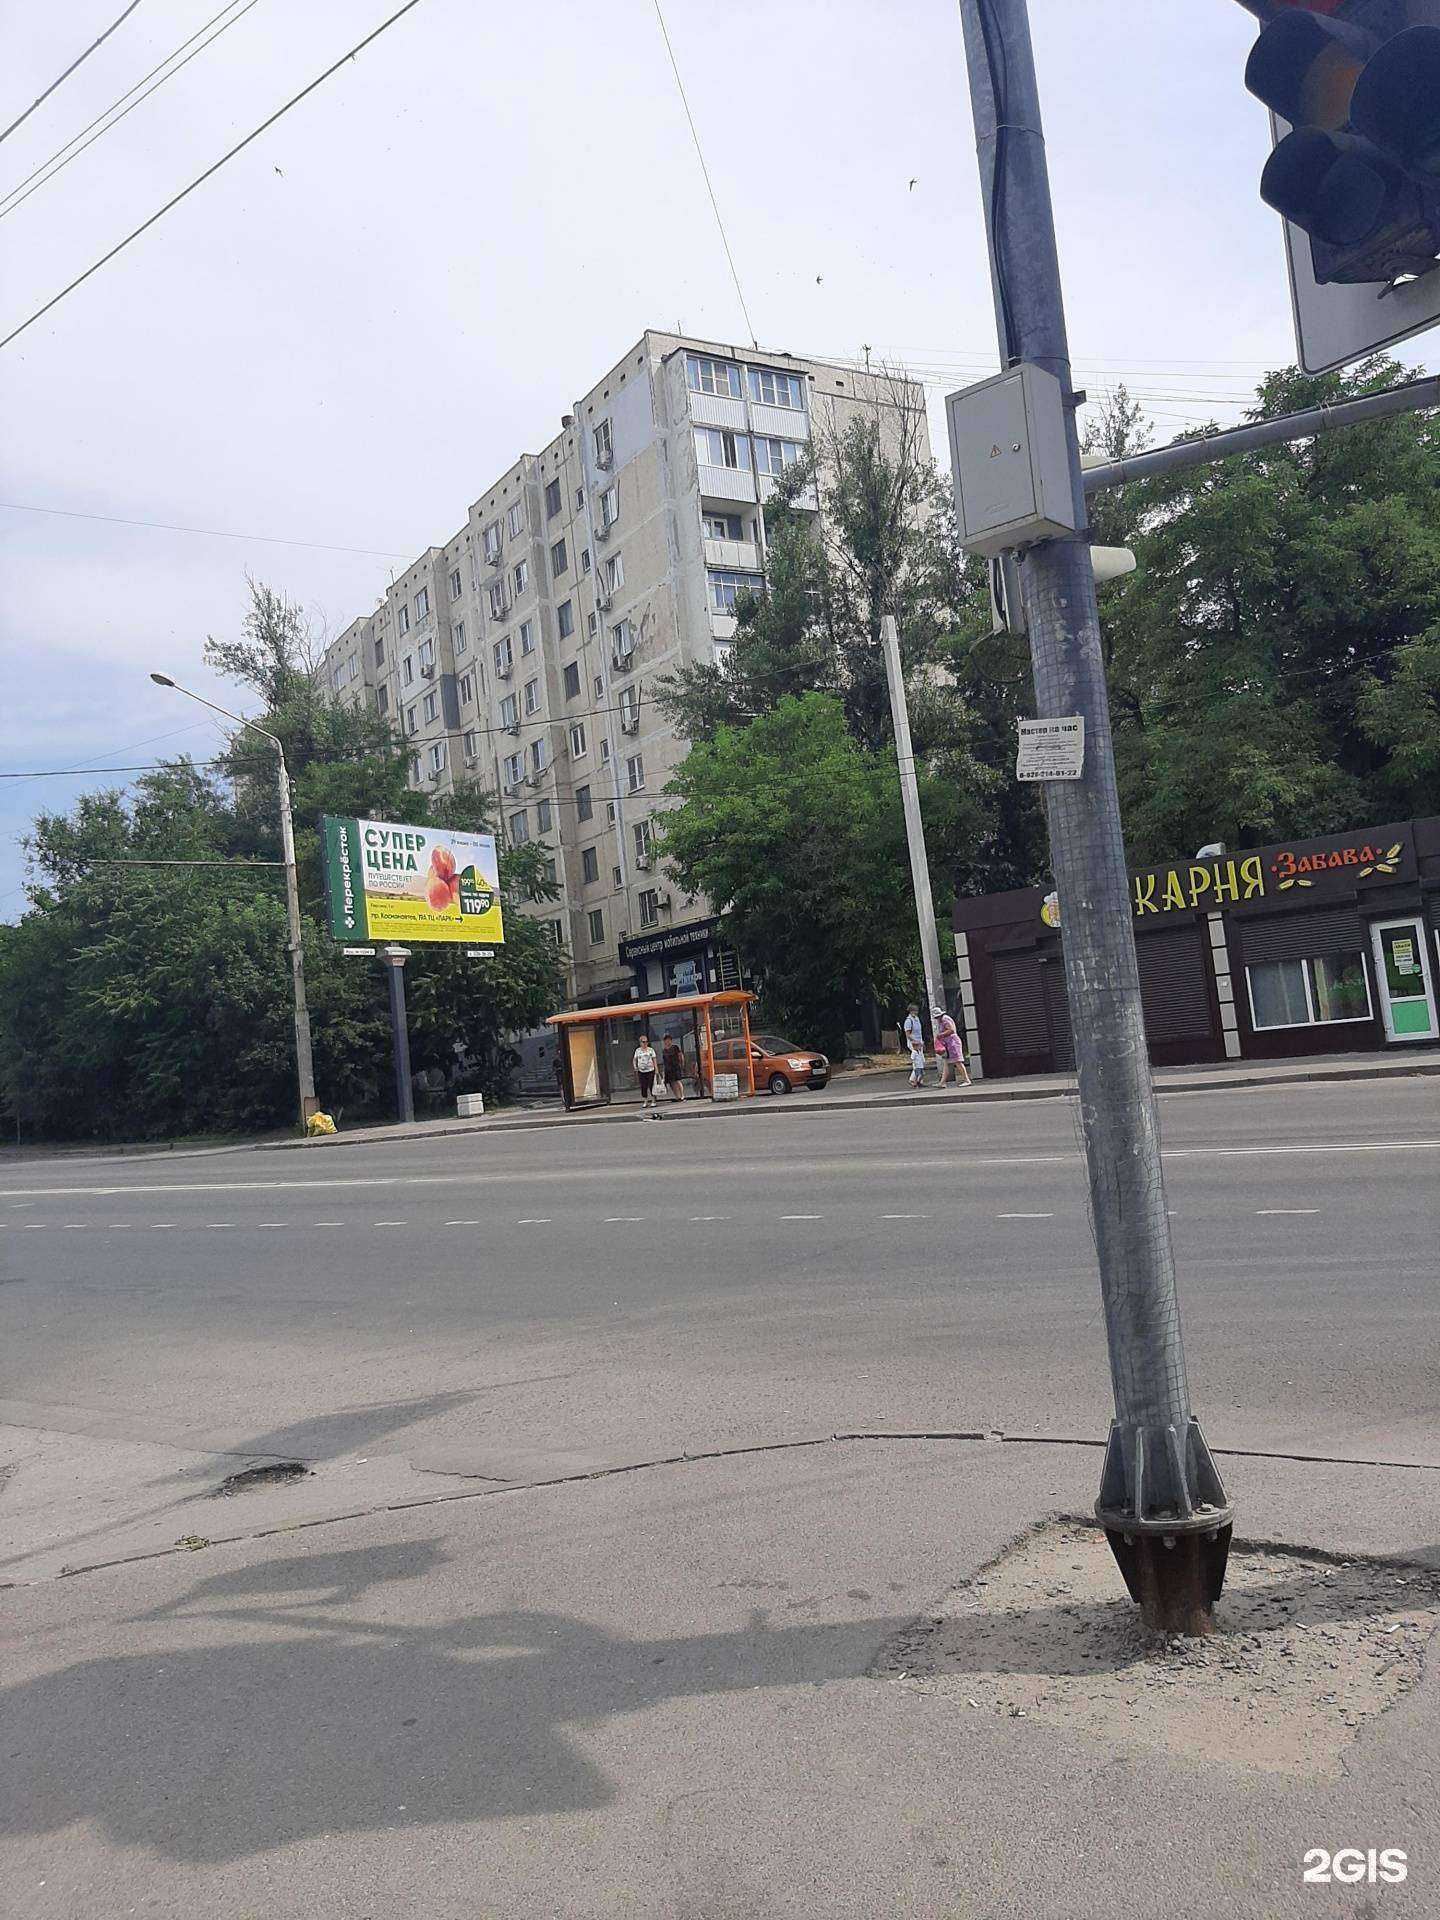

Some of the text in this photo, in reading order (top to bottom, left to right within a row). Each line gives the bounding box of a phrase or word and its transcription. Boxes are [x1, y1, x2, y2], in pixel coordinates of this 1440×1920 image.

[365, 829, 426, 851] СУПЕР
[366, 850, 418, 871] ЦЕНА
[340, 826, 355, 914] Перекрёсток
[1135, 856, 1265, 916] КАРНЯ
